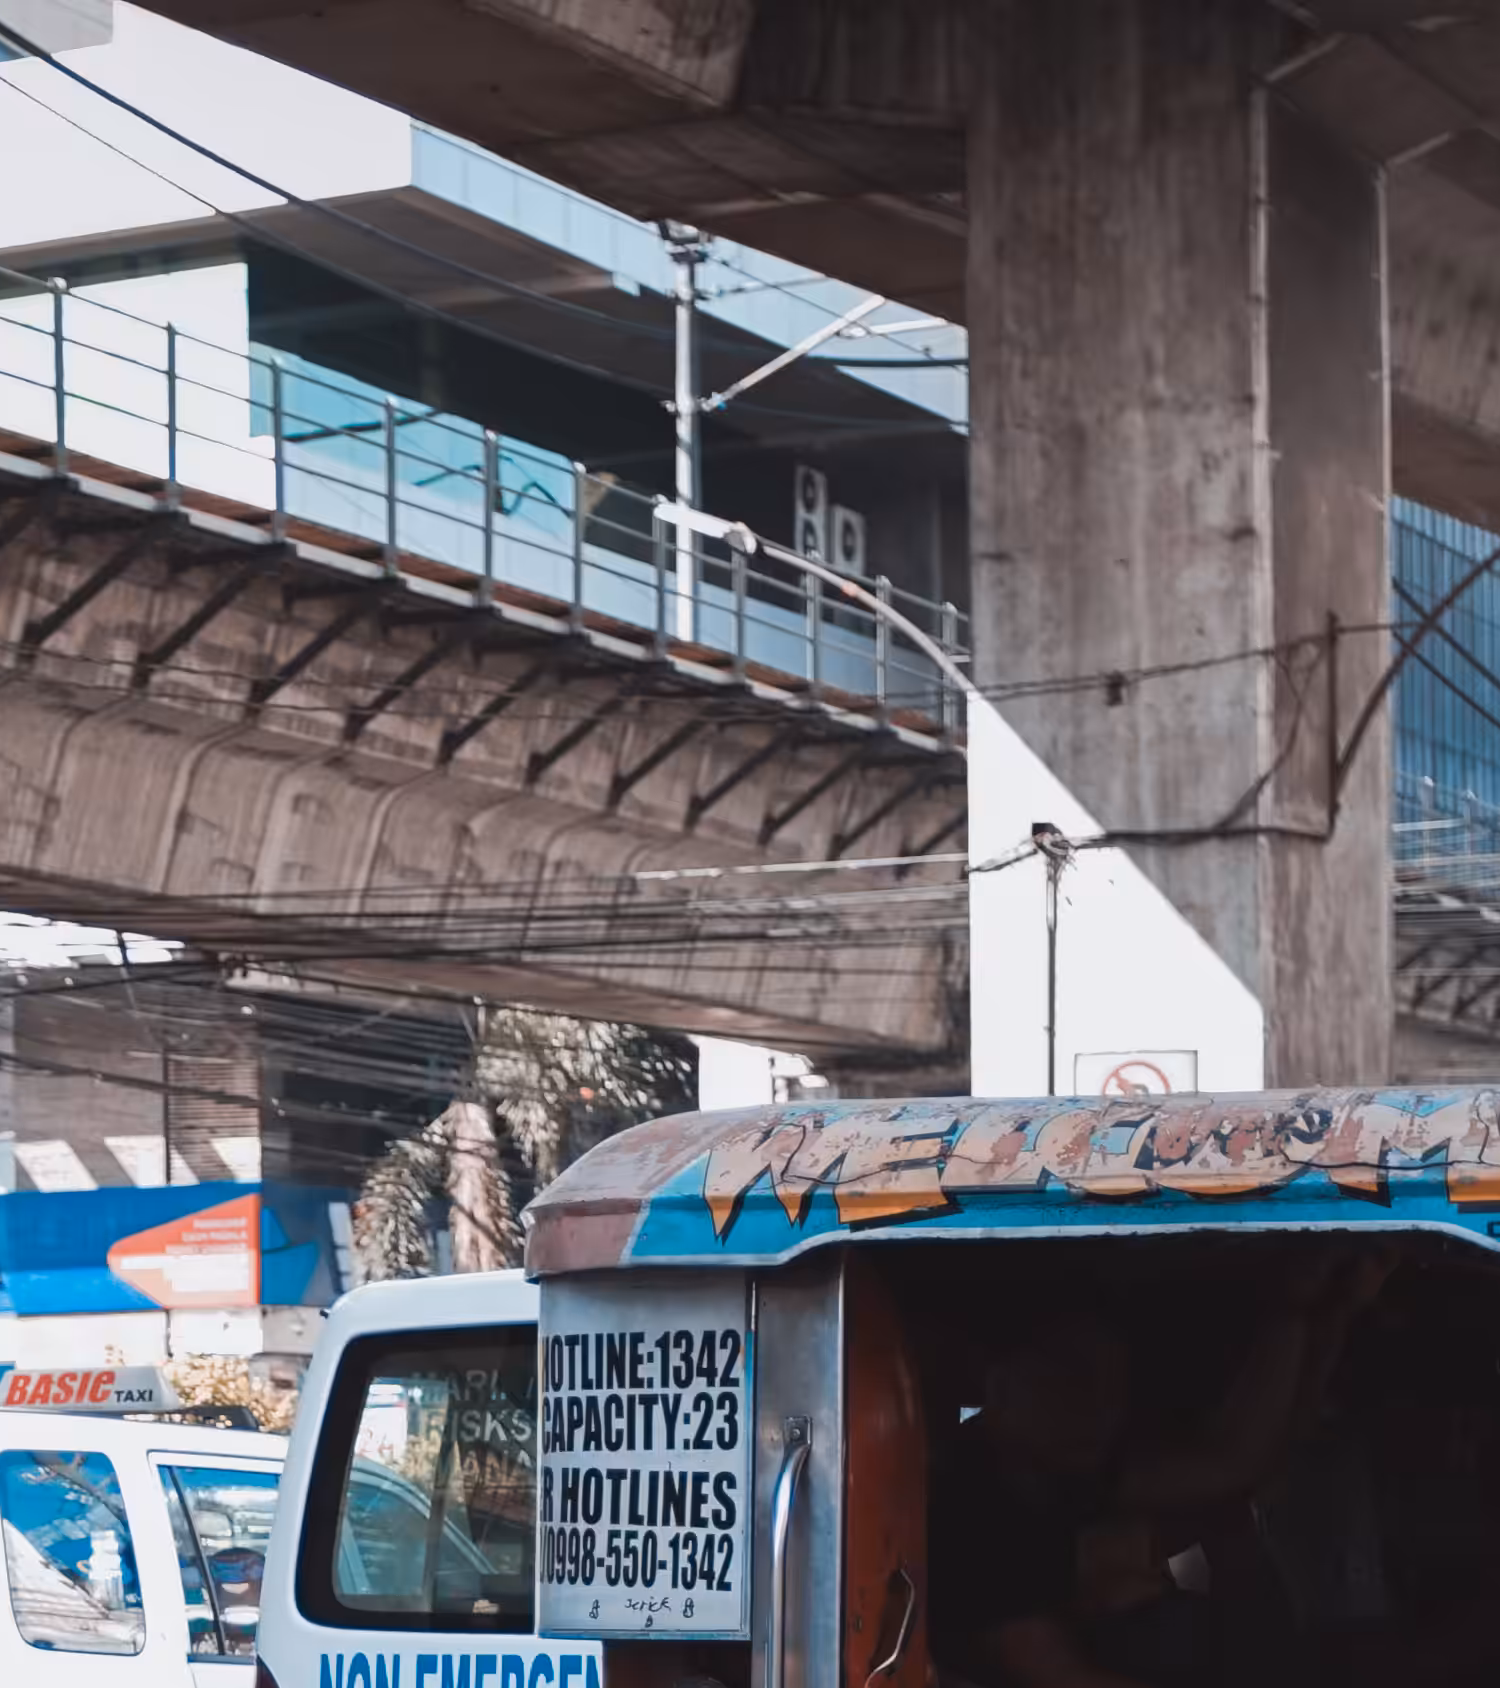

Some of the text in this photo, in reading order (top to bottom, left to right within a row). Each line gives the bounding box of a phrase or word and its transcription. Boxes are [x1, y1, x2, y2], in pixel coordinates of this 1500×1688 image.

[5, 1370, 154, 1408] BASIC TAXI
[560, 1467, 738, 1531] HOTLINES
